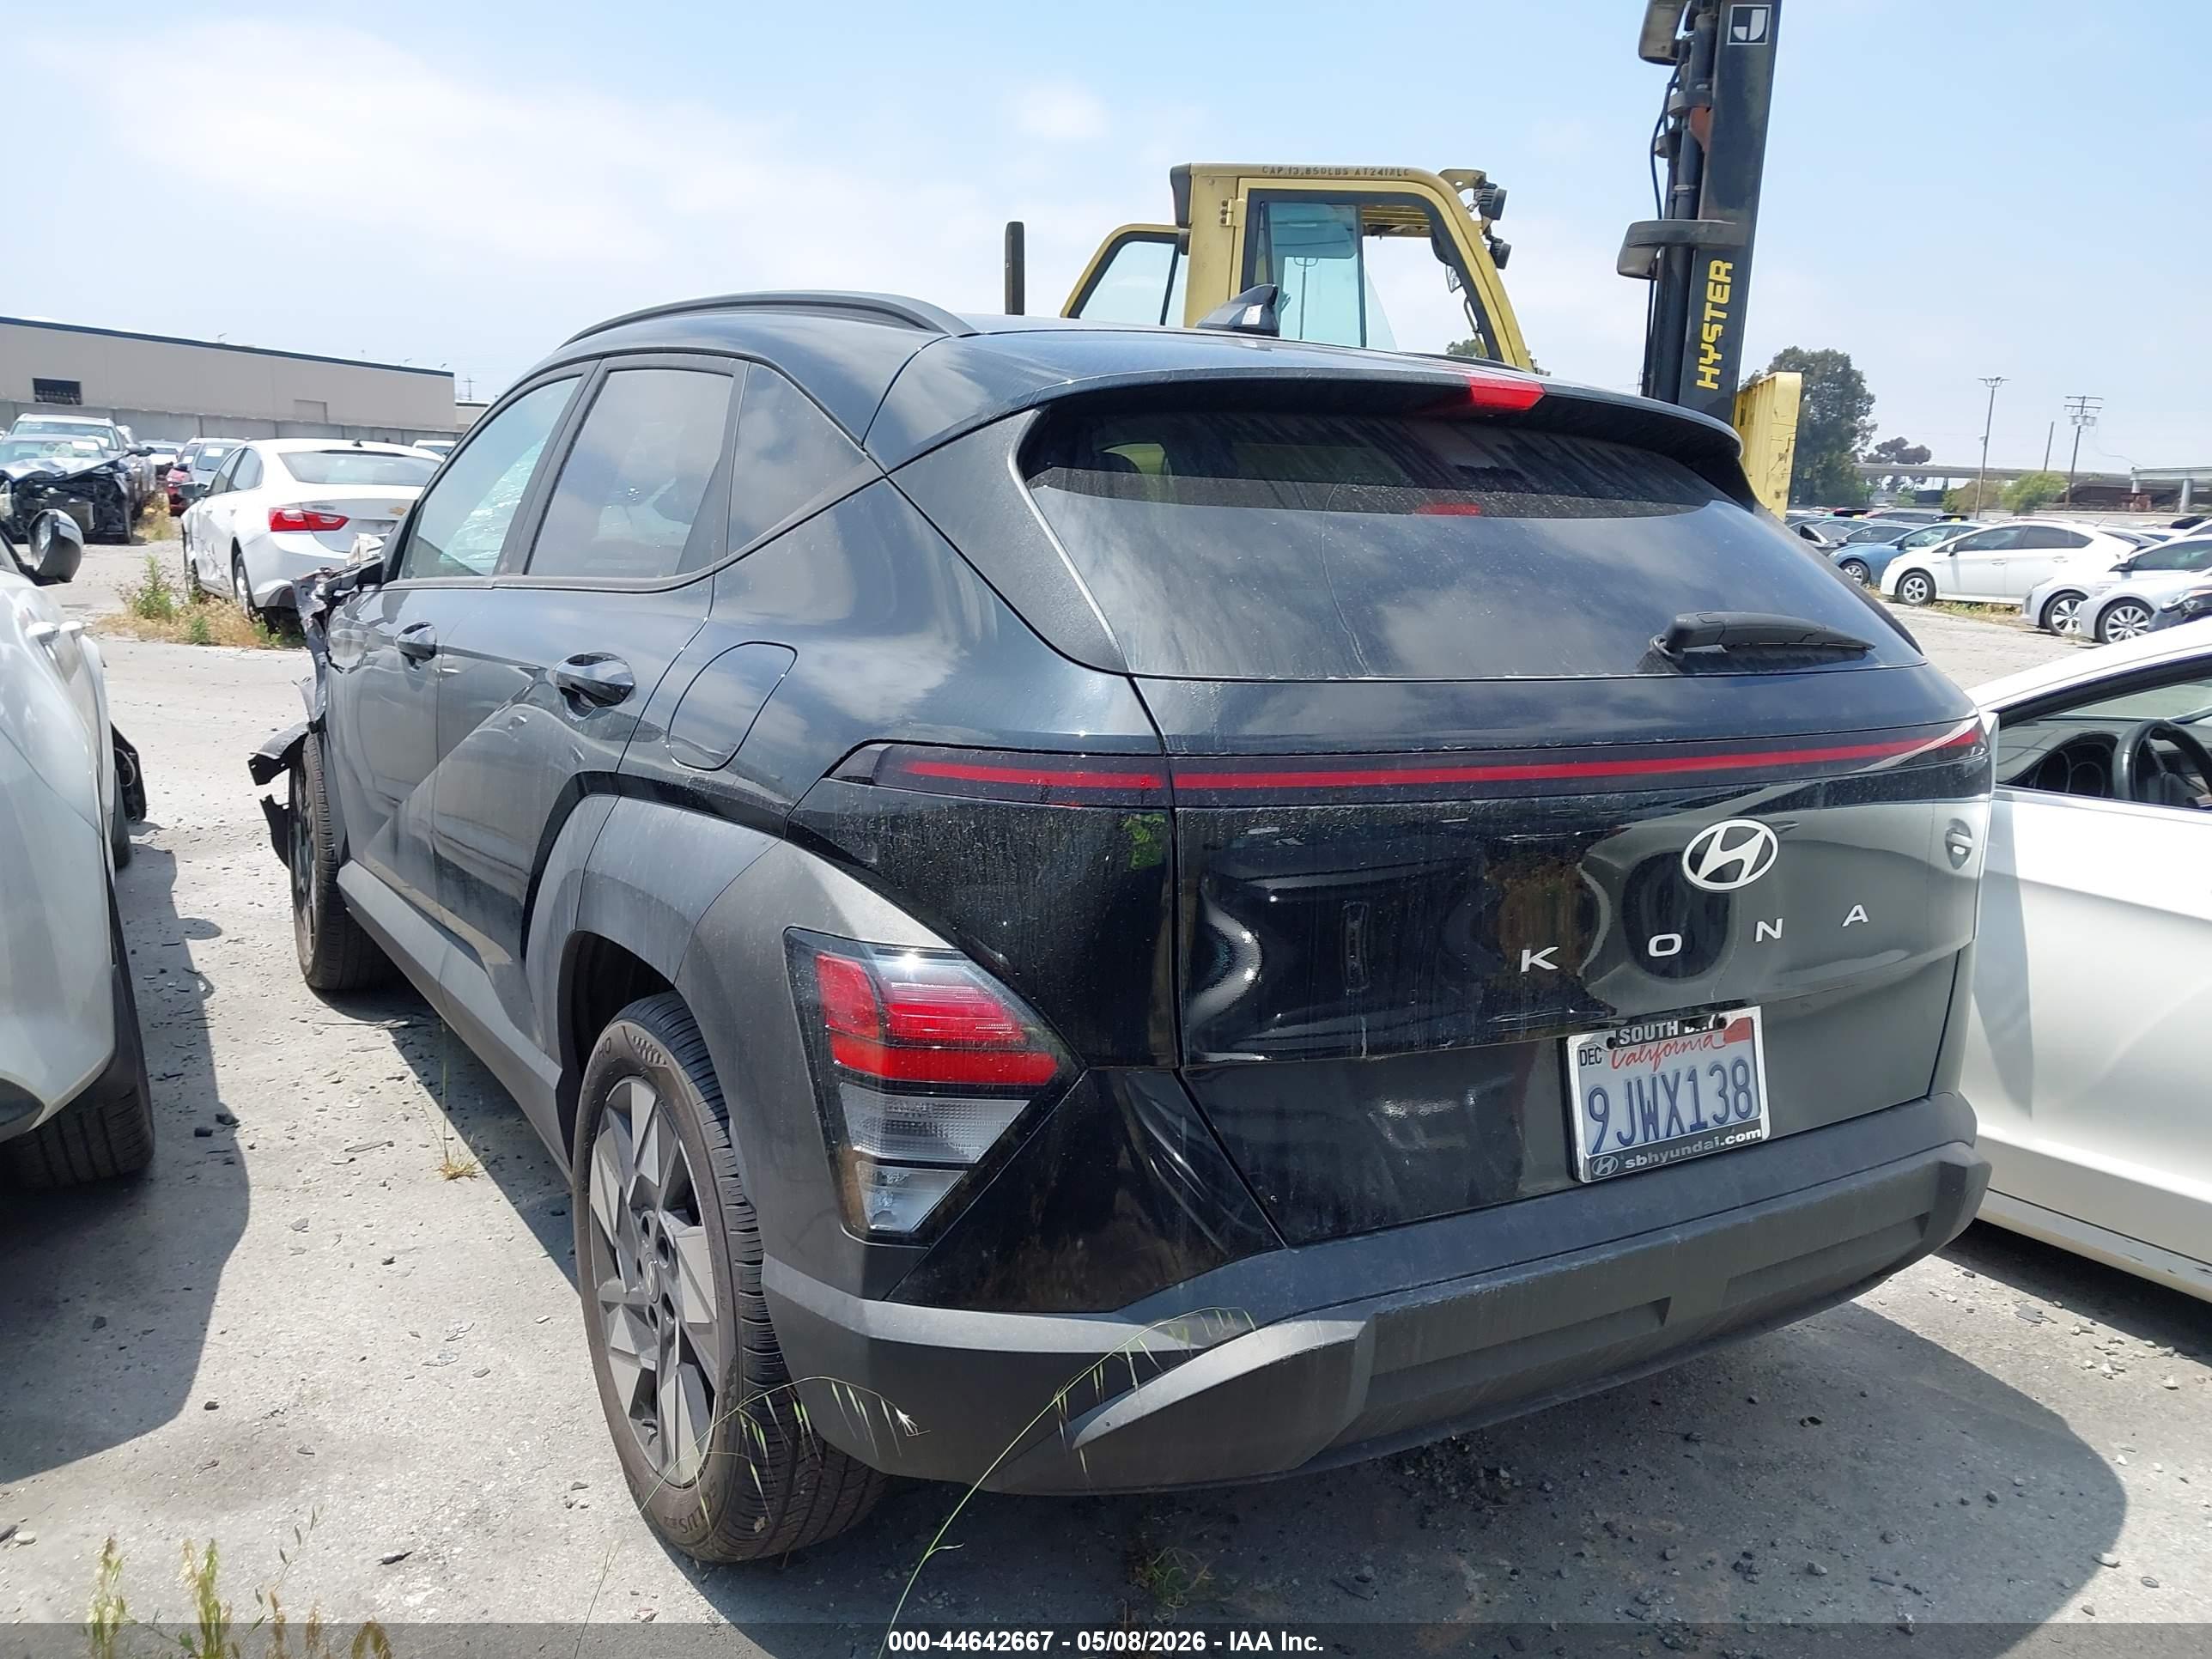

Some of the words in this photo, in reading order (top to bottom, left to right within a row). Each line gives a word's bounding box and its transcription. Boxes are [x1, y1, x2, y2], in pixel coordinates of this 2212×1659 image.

[1696, 260, 1734, 390] HYSTER
[1520, 904, 1869, 973] KONA
[1611, 1032, 1725, 1072] California
[1620, 1020, 1679, 1045] SOUTH
[1580, 1047, 1602, 1066] DEC
[1589, 1059, 1752, 1154] 9JWX138
[1625, 1127, 1761, 1169] sbhyundai.com
